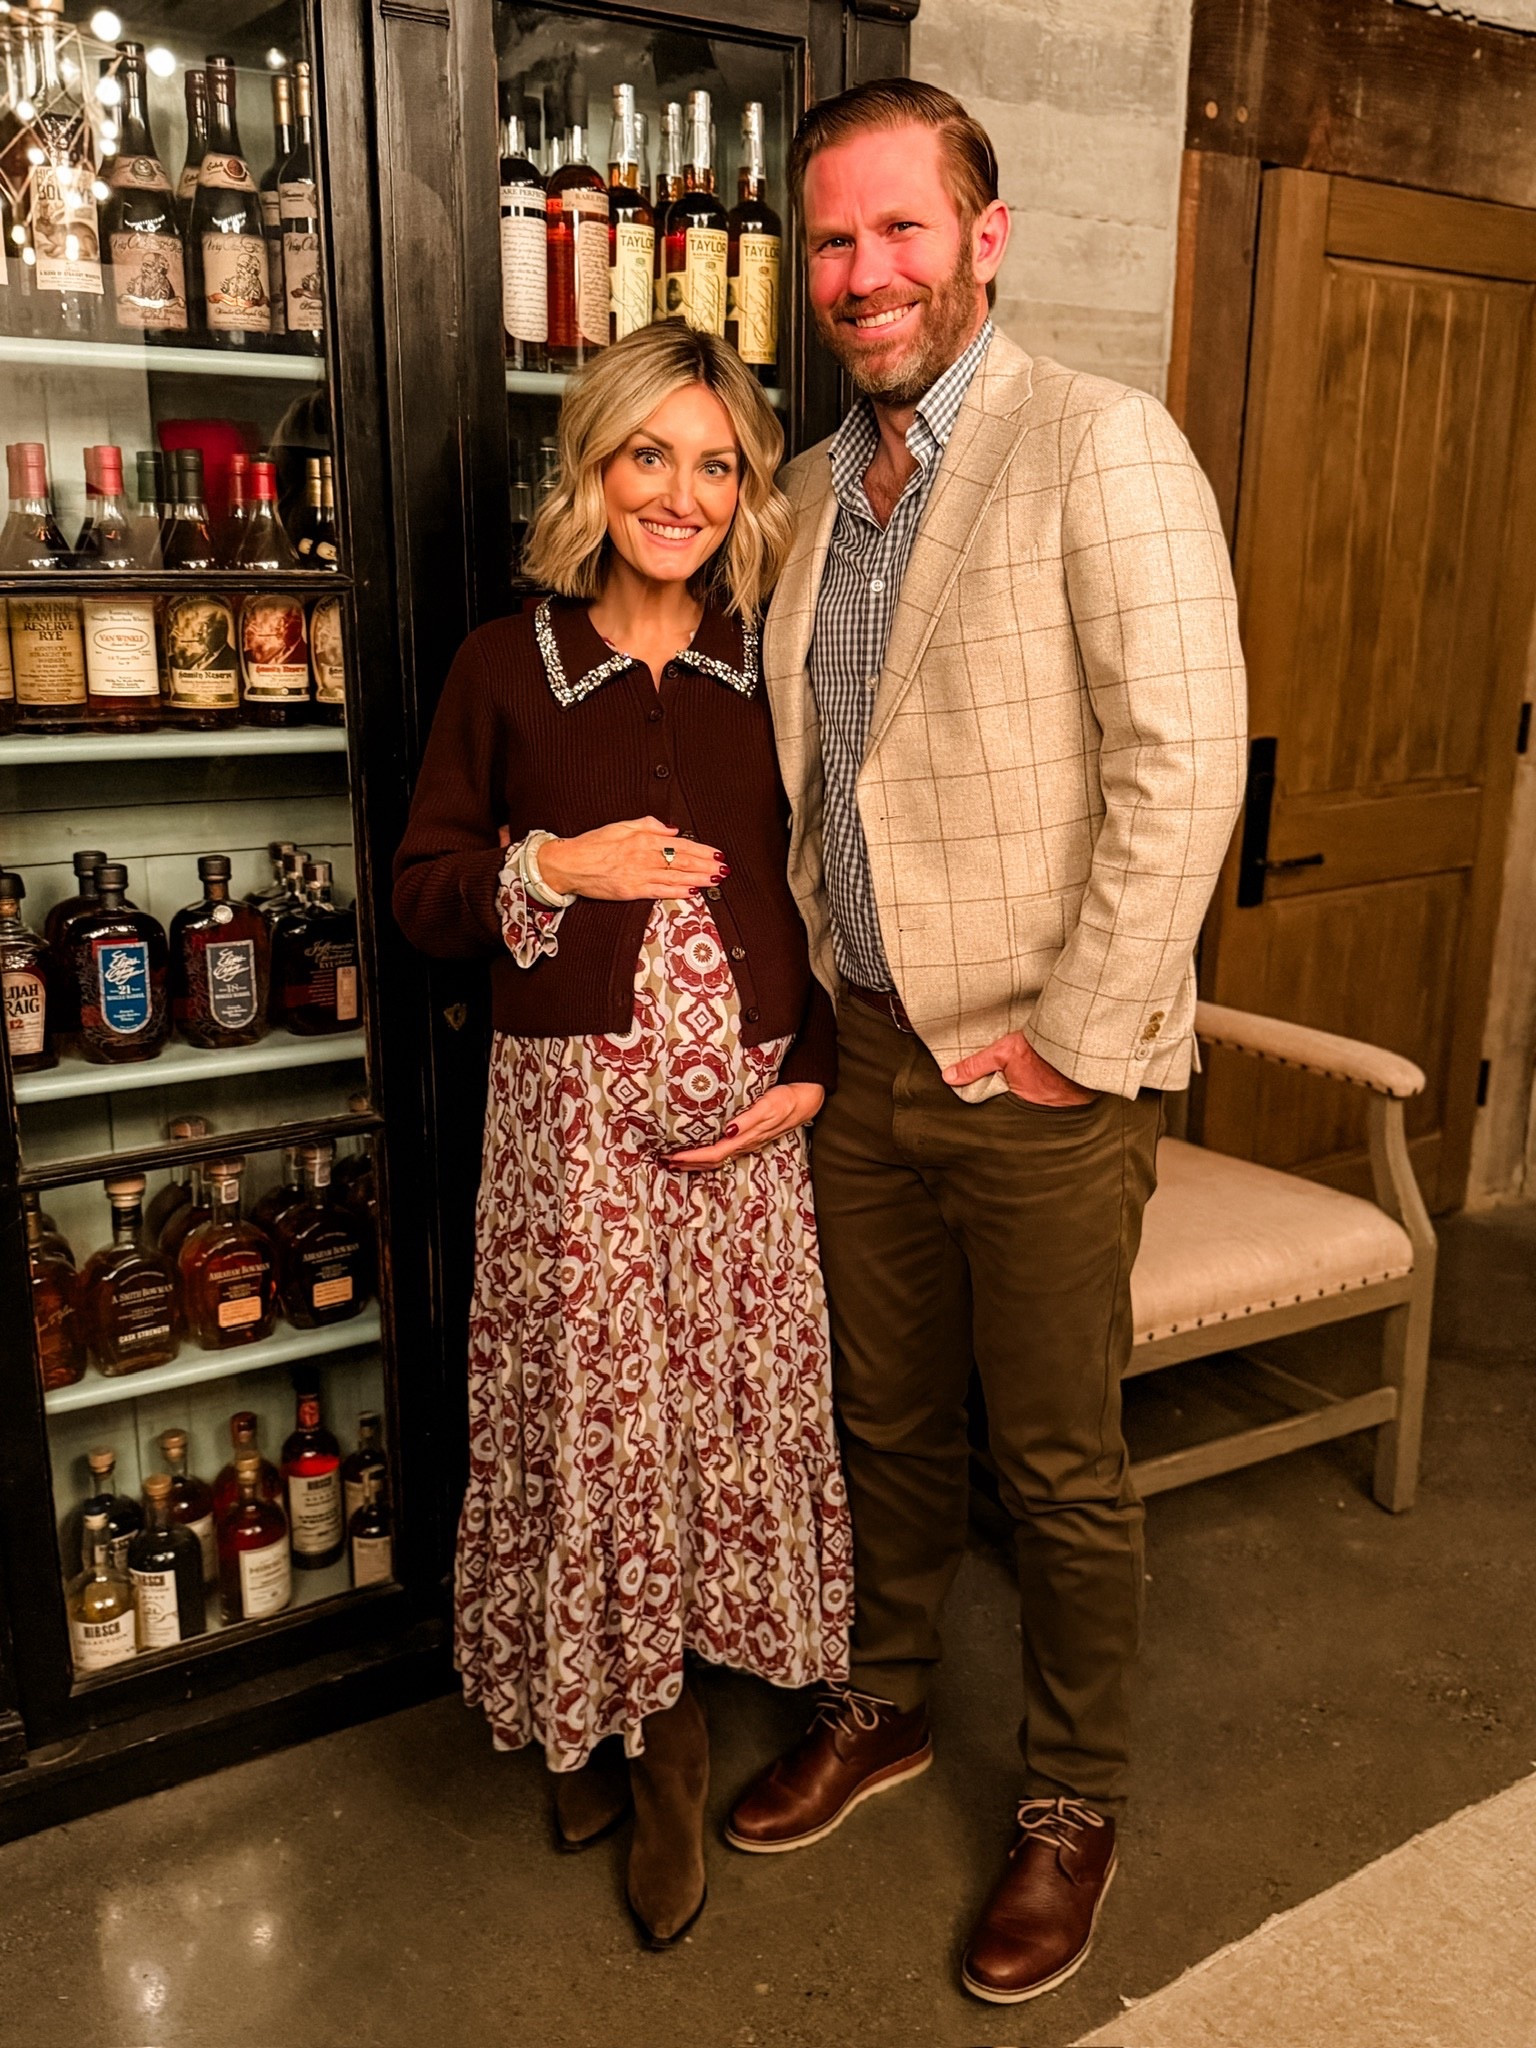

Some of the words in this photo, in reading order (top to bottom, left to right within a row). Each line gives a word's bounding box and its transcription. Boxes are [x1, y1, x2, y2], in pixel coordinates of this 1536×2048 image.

[689, 239, 727, 254] TAYLOR
[26, 612, 70, 622] FAMILY
[24, 621, 75, 631] RESERVE
[39, 630, 64, 641] RYE
[3, 983, 39, 1001] LIJAH
[118, 985, 131, 995] 21
[4, 997, 40, 1017] RAIG
[10, 1019, 24, 1029] 12
[84, 1621, 121, 1638] HIRSCH
